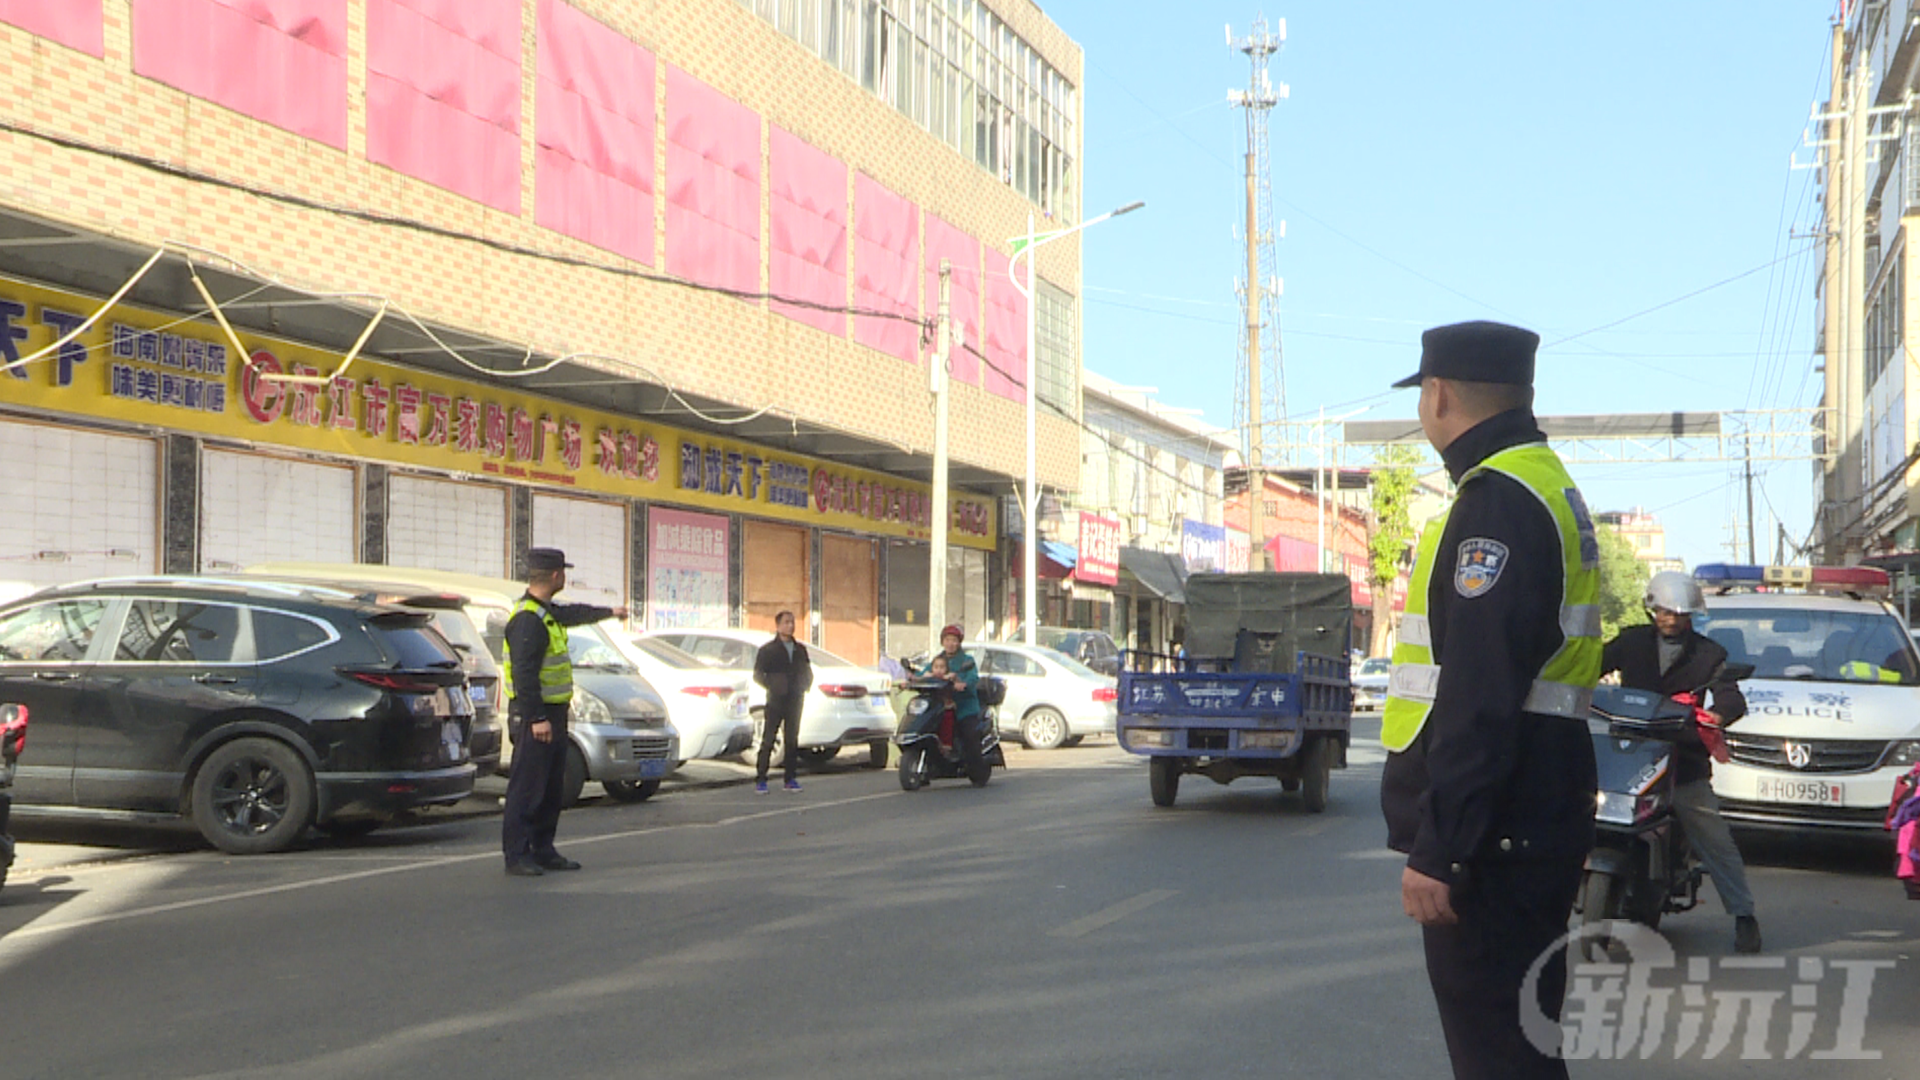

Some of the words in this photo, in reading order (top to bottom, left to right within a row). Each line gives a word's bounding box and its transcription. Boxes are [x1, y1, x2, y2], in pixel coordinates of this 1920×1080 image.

[291, 362, 583, 470] 沅江市富万家购物广场
[598, 426, 661, 483] 欢迎您
[1131, 684, 1167, 704] 江苏
[1744, 704, 1854, 723] POLICE
